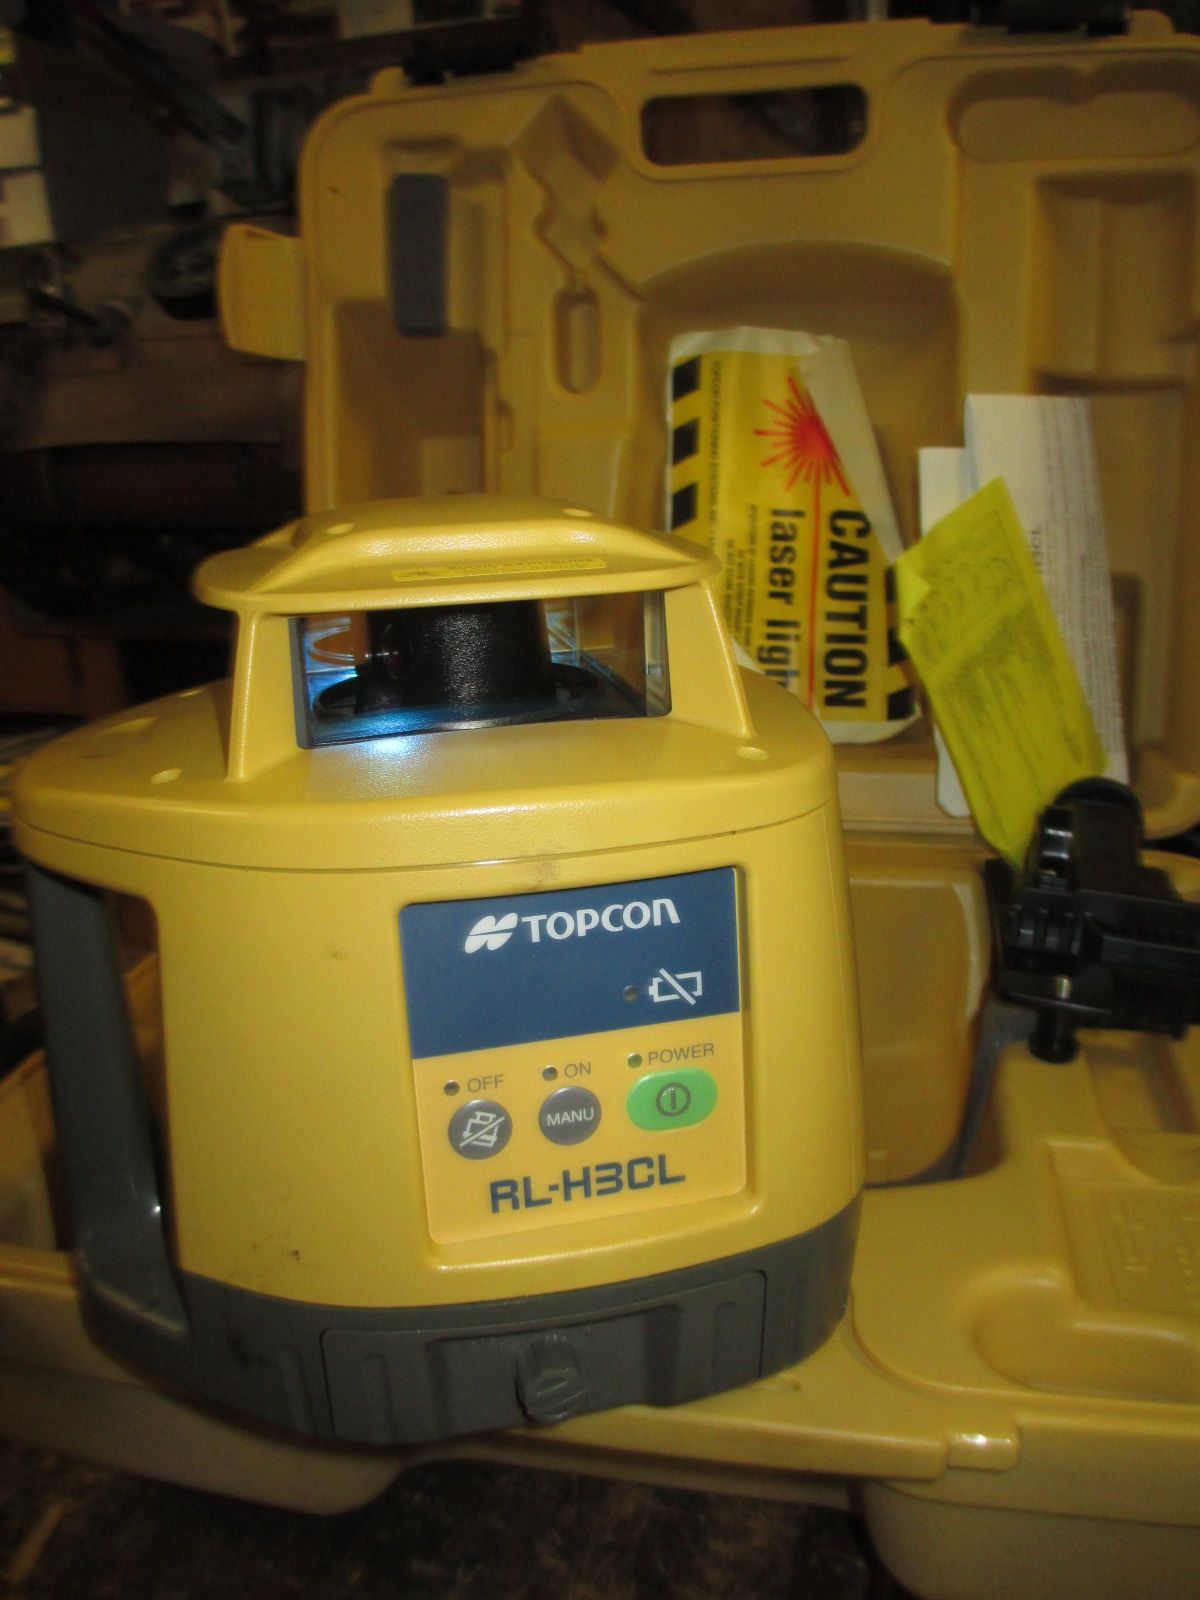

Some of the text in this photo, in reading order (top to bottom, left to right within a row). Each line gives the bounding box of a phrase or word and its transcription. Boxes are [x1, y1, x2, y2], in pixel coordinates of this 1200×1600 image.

[756, 508, 806, 688] laser ligh
[823, 509, 871, 708] CAUTION
[521, 898, 680, 943] TOPCON
[564, 1062, 592, 1079] ON
[647, 1043, 714, 1066] POWER
[467, 1074, 504, 1093] OFF
[546, 1107, 594, 1126] MANU
[489, 1154, 686, 1214] RL-H3CL
